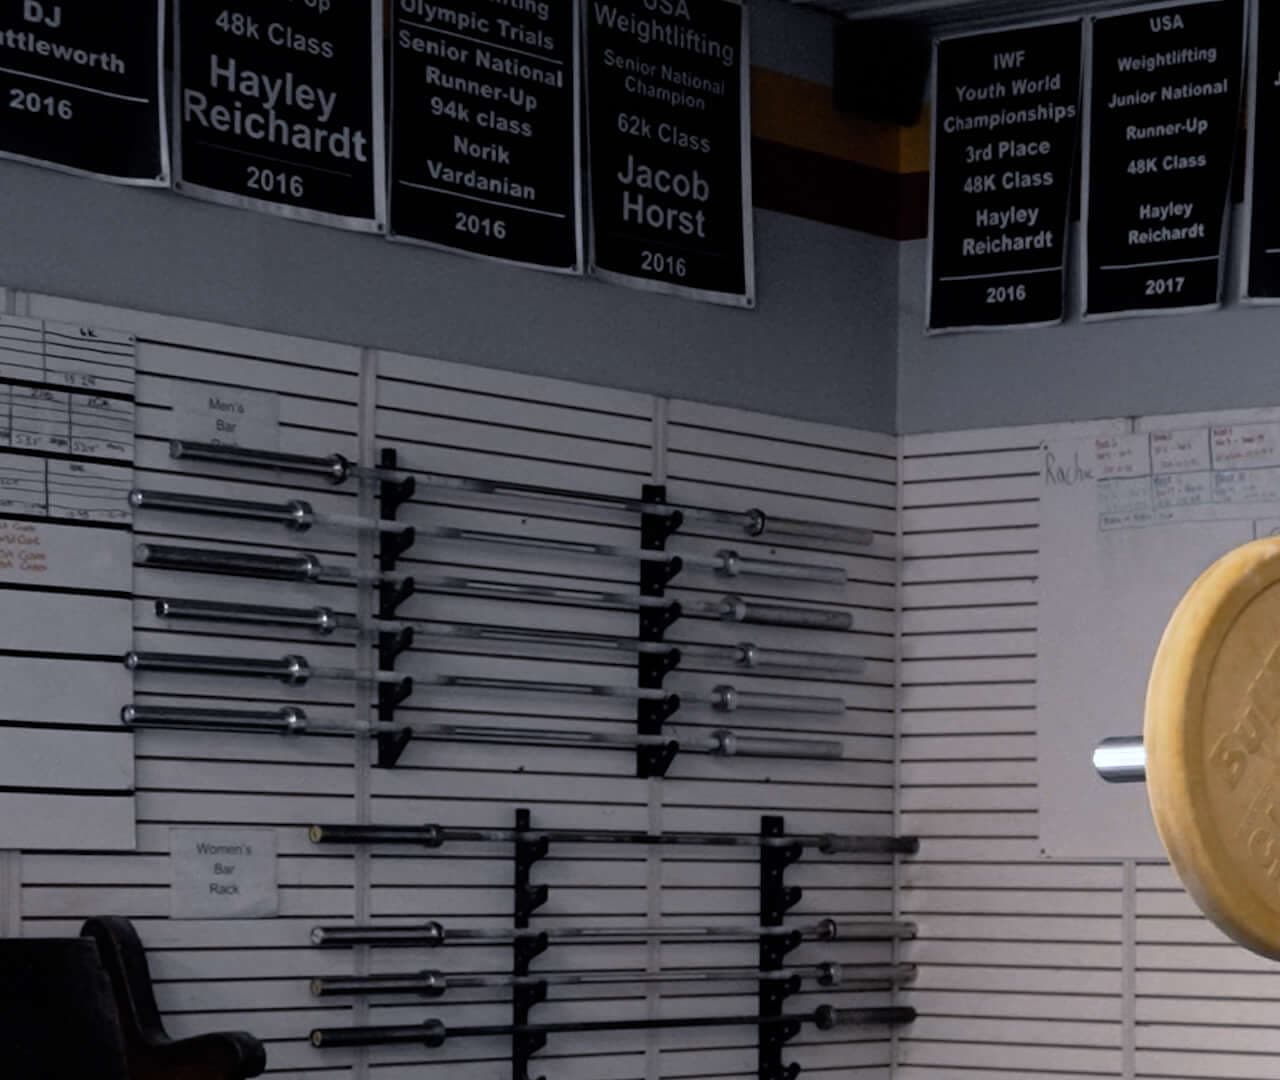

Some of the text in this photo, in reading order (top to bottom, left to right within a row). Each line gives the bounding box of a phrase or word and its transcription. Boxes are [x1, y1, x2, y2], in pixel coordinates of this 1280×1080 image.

[24, 0, 60, 27] DJ
[644, 0, 690, 20] USA
[1150, 14, 1184, 32] USA
[216, 11, 333, 58] 48k Class
[401, 0, 489, 32] Olympic
[497, 19, 553, 50] Trials
[594, 2, 735, 66] Weightlifting
[0, 30, 124, 73] ttleworth
[400, 30, 563, 88] Senior National
[994, 50, 1024, 69] IWF
[1118, 48, 1217, 71] Weightlifting
[604, 49, 724, 94] Senior National
[210, 54, 337, 122] Hayley
[425, 66, 537, 112] Runner-Up
[625, 76, 705, 110] Champion
[956, 74, 1060, 101] Youth World
[1109, 79, 1227, 108] Junior National
[10, 89, 72, 119] 2016
[431, 97, 532, 136] 94k class
[944, 103, 1075, 133] Championships
[184, 88, 367, 162] Reichardt
[618, 113, 710, 152] 62k Class
[1126, 118, 1208, 140] Runner-Up
[454, 136, 509, 164] Norik
[967, 141, 1050, 163] 3rd Place
[618, 155, 709, 201] Jacob
[1128, 155, 1206, 174] 48K Class
[248, 166, 303, 197] 2016
[427, 160, 535, 200] Vardanian
[964, 172, 1053, 192] 48K Class
[623, 191, 704, 237] Horst
[977, 206, 1038, 229] Hayley
[1140, 202, 1193, 220] Hayley
[456, 212, 506, 239] 2016
[1129, 223, 1204, 244] Reichardt
[963, 231, 1052, 255] Reichardt
[641, 251, 686, 276] 2016
[987, 285, 1026, 303] 2016
[1146, 277, 1184, 295] 2017
